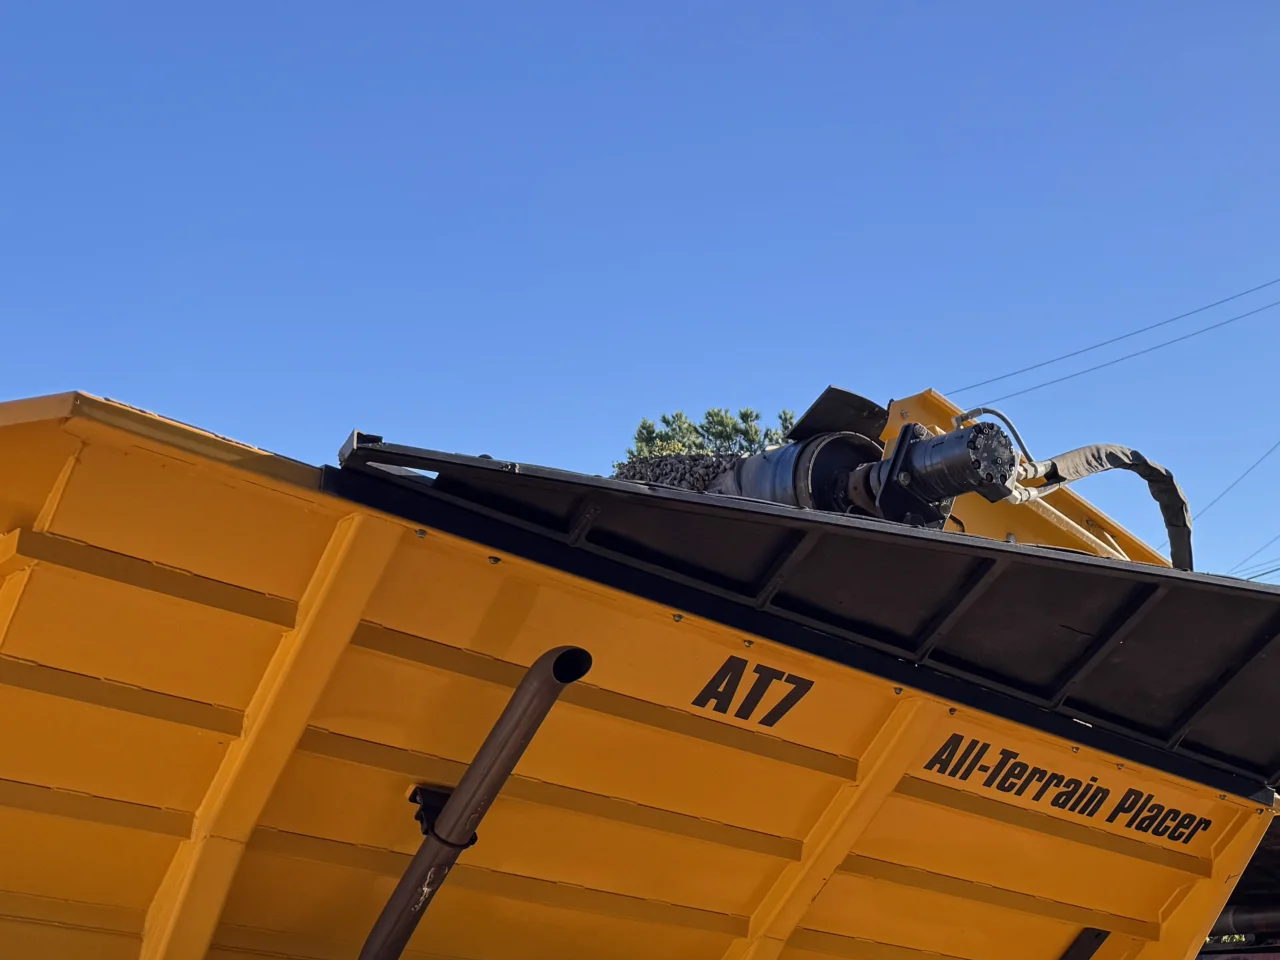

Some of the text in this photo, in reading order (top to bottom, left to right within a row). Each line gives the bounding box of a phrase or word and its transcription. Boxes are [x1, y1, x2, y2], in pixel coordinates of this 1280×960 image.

[690, 654, 815, 728] AT7
[923, 732, 1213, 845] All-Terrain Placer
